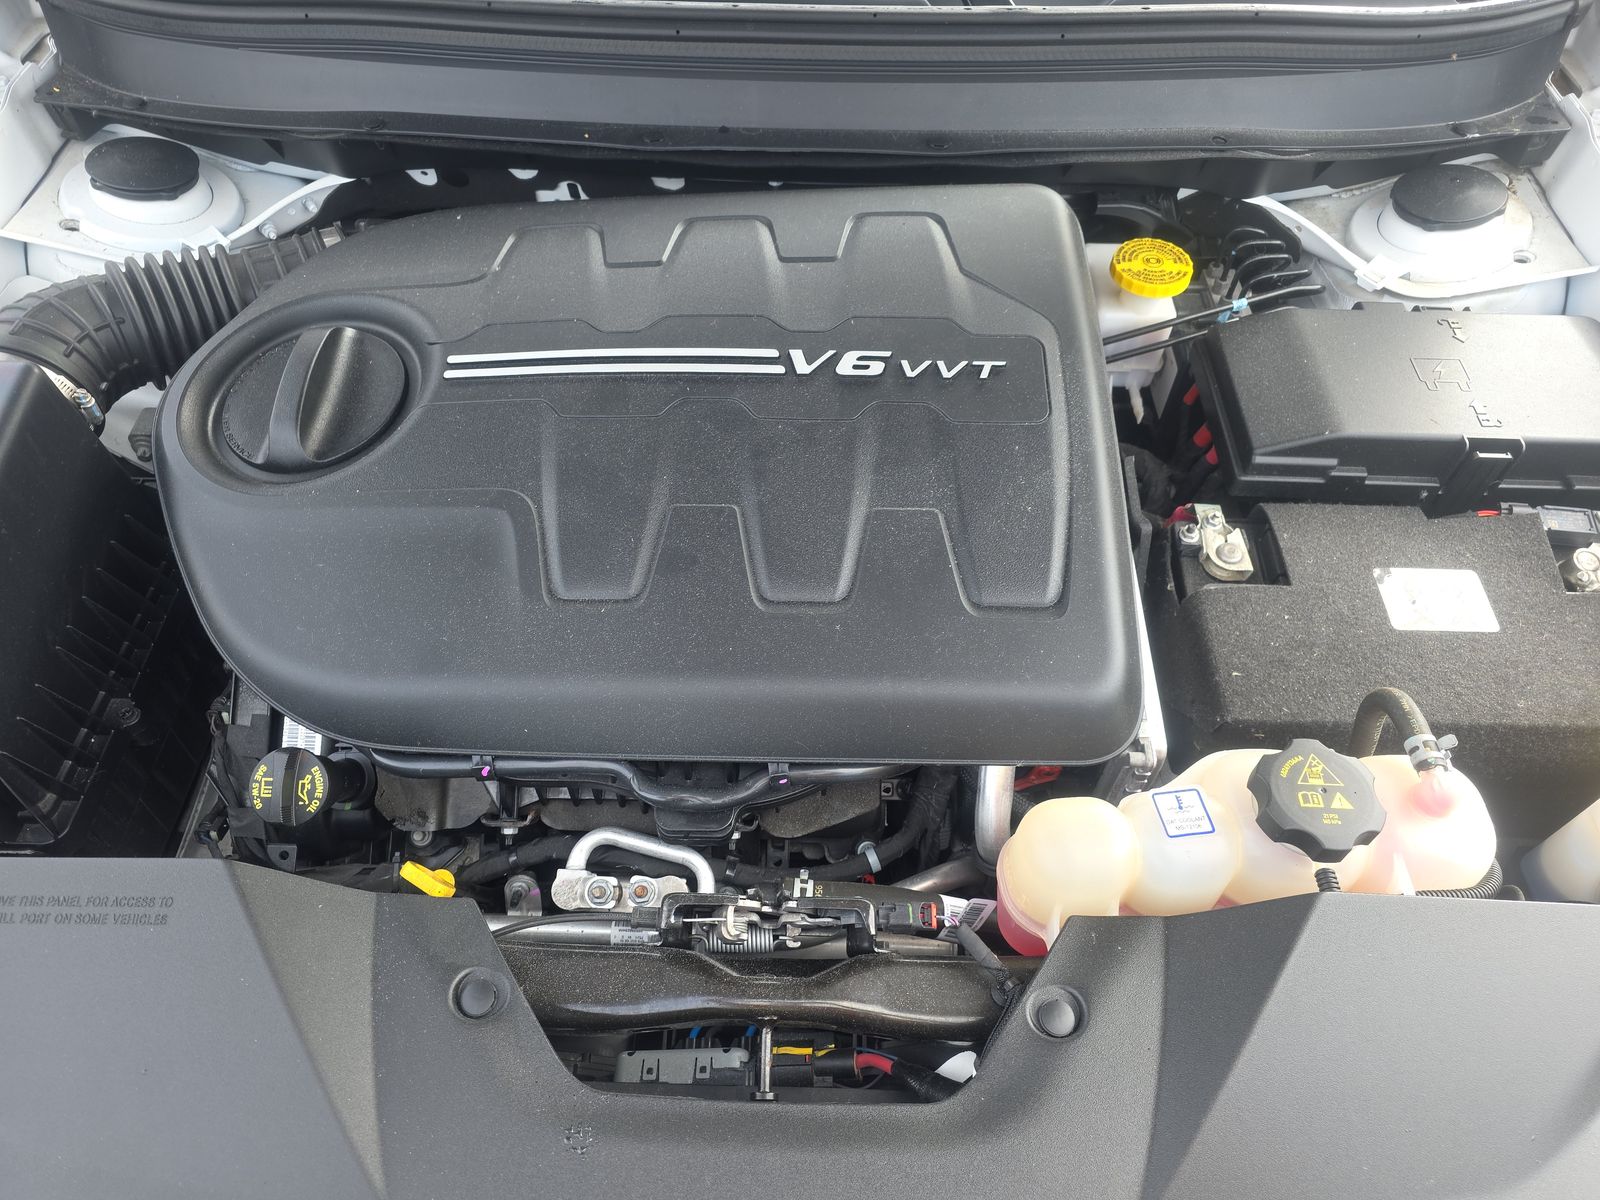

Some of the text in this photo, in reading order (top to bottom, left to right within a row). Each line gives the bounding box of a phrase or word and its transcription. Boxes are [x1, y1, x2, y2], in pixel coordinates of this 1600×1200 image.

[788, 349, 1007, 379] V6 VVT
[251, 764, 267, 810] SAE 5W-20
[306, 765, 324, 813] ENGINE OIL
[18, 895, 45, 907] THIS
[46, 895, 83, 908] PANEL
[85, 895, 109, 908] FOR
[110, 895, 157, 908] ACCESS
[158, 895, 174, 908] TO
[19, 912, 52, 925] PORT
[54, 912, 73, 925] ON
[74, 912, 109, 926] SOME
[112, 912, 169, 926] VEHICLES
